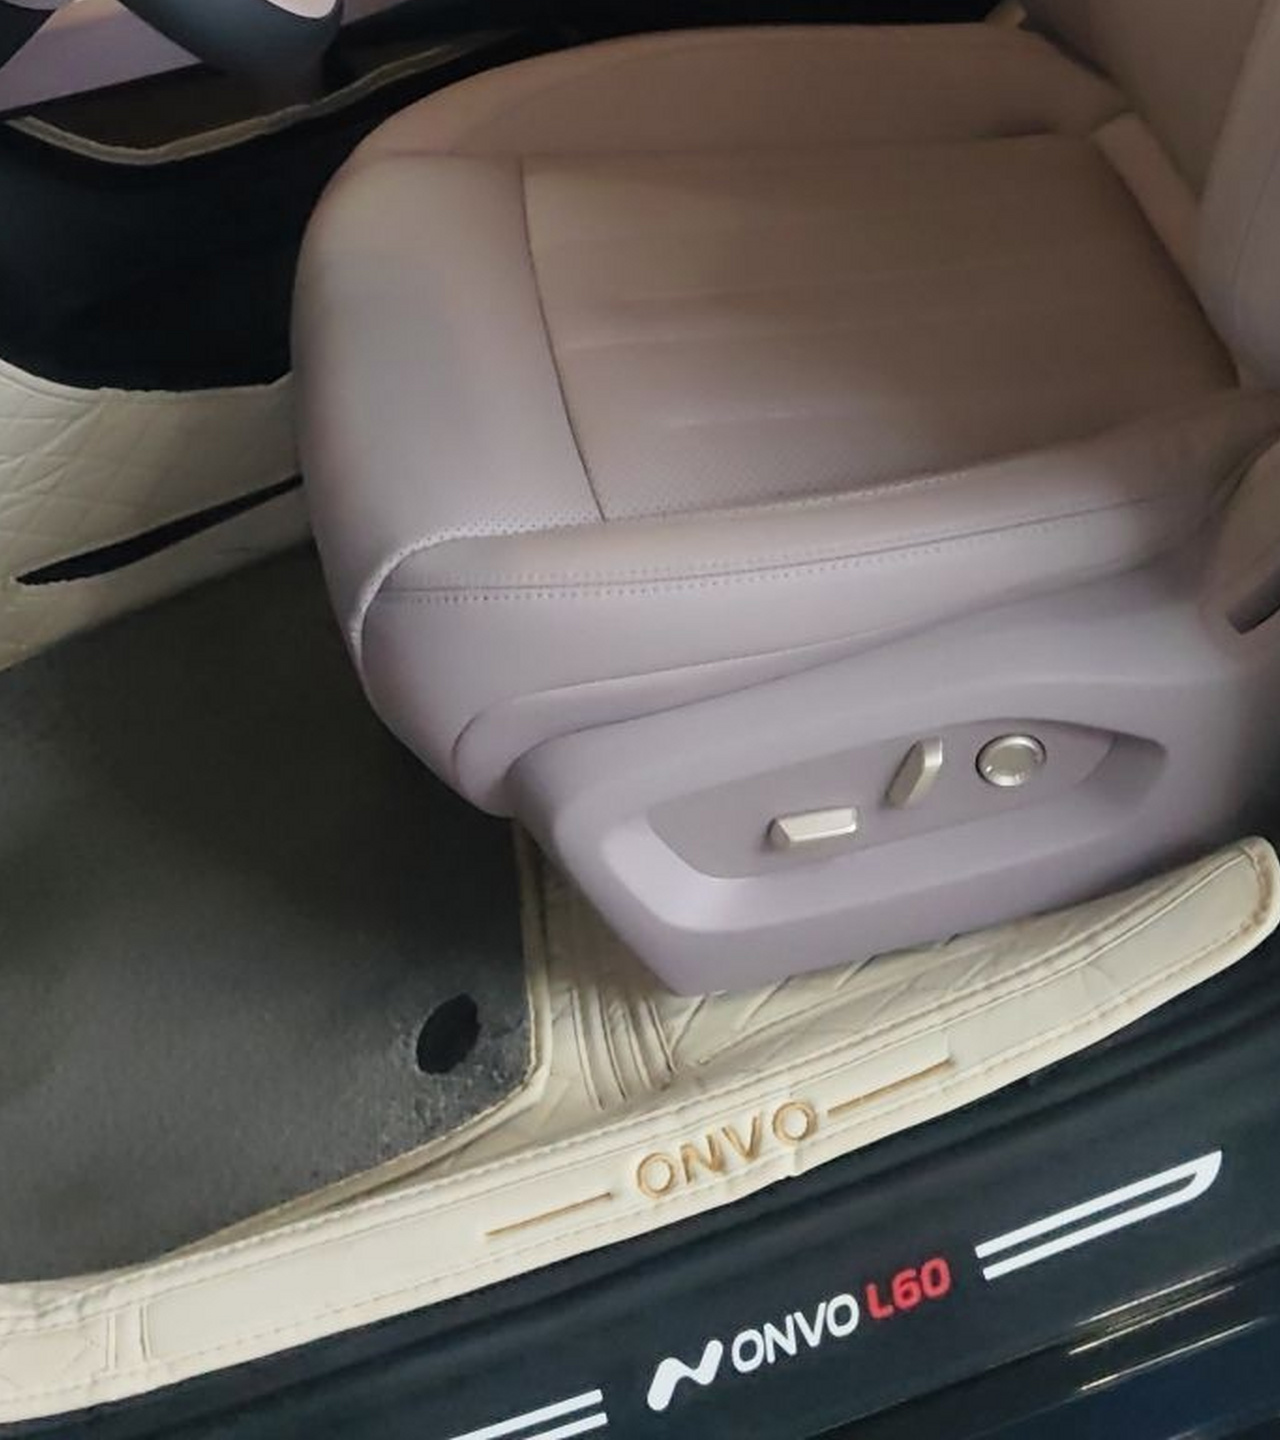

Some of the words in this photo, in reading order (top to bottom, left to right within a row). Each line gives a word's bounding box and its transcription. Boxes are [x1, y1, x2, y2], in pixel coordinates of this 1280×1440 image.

[636, 1100, 819, 1199] ONVO
[731, 1293, 861, 1374] ONVO
[865, 1257, 953, 1320] L60
